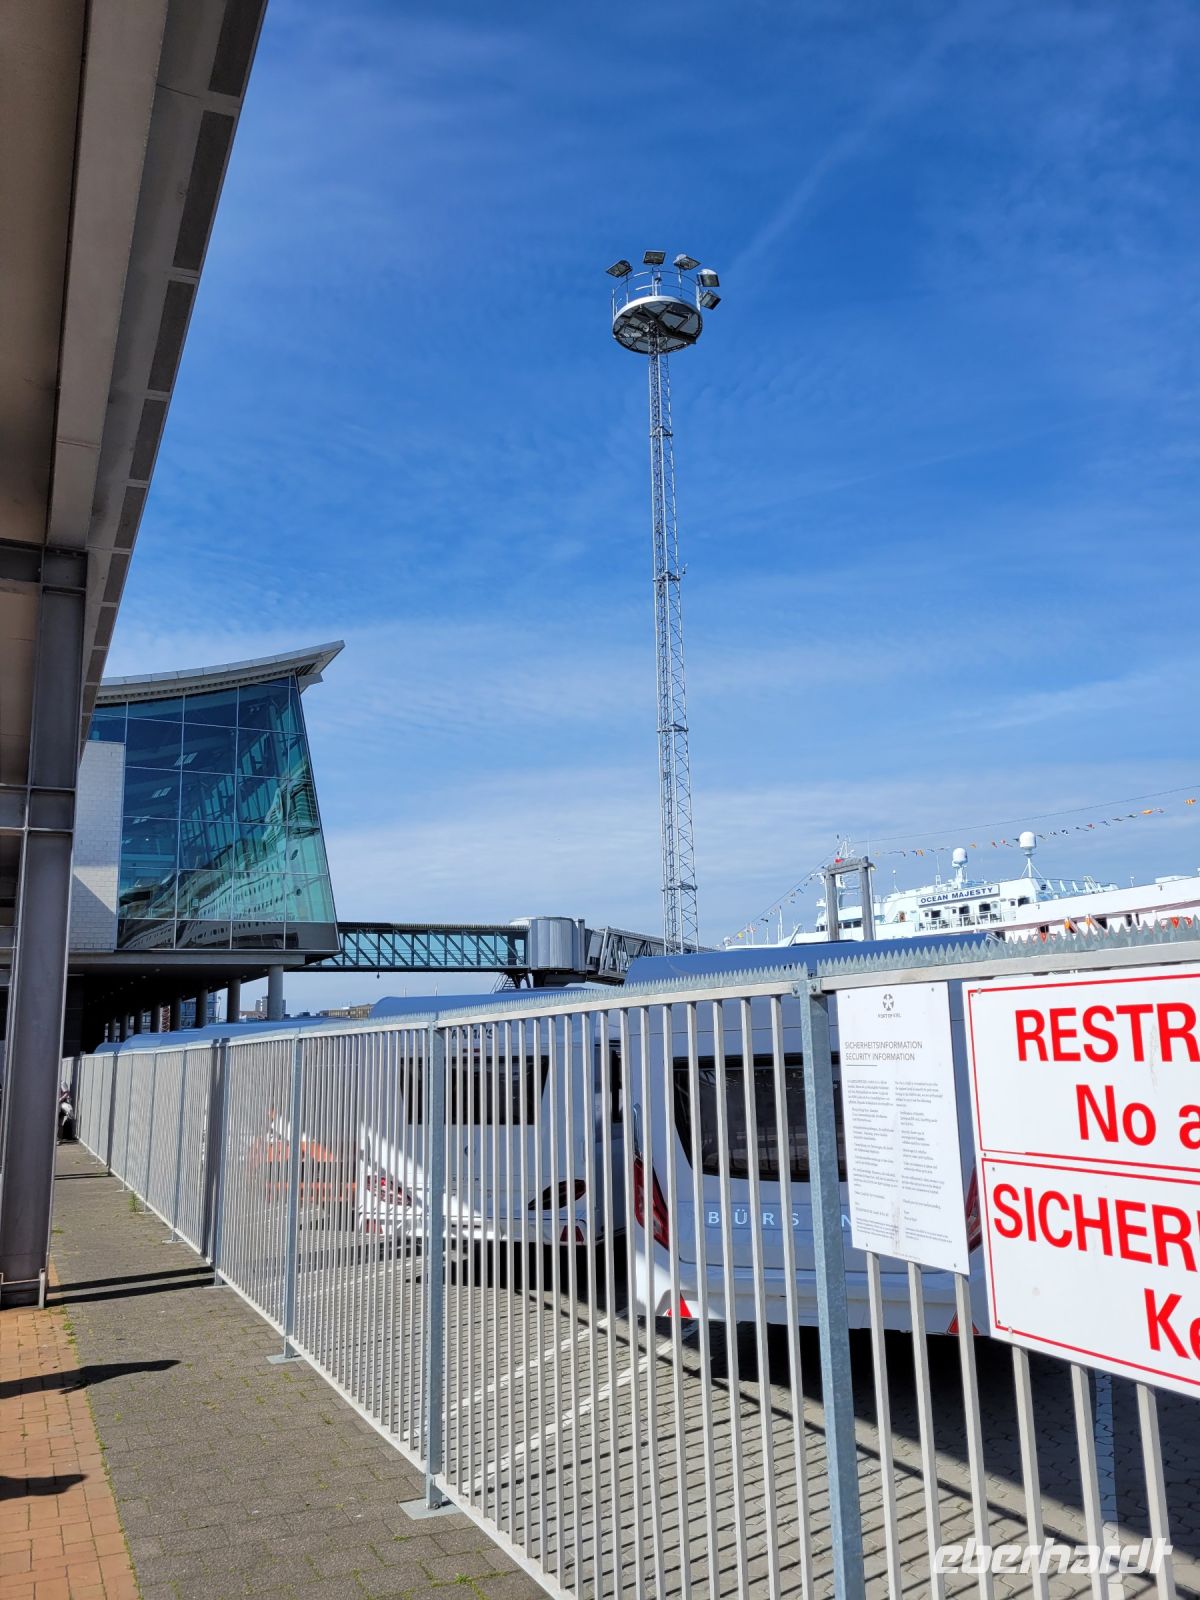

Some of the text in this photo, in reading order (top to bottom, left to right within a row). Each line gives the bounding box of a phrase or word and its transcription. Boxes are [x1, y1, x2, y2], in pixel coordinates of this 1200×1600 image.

[921, 888, 993, 904] OCEAN MAJESTY
[844, 1041, 923, 1050] SICHERHEITSINFORMATION
[845, 1053, 915, 1061] SECURITY INFORMATION
[1075, 1084, 1156, 1146] No
[993, 1183, 1200, 1273] SICHER
